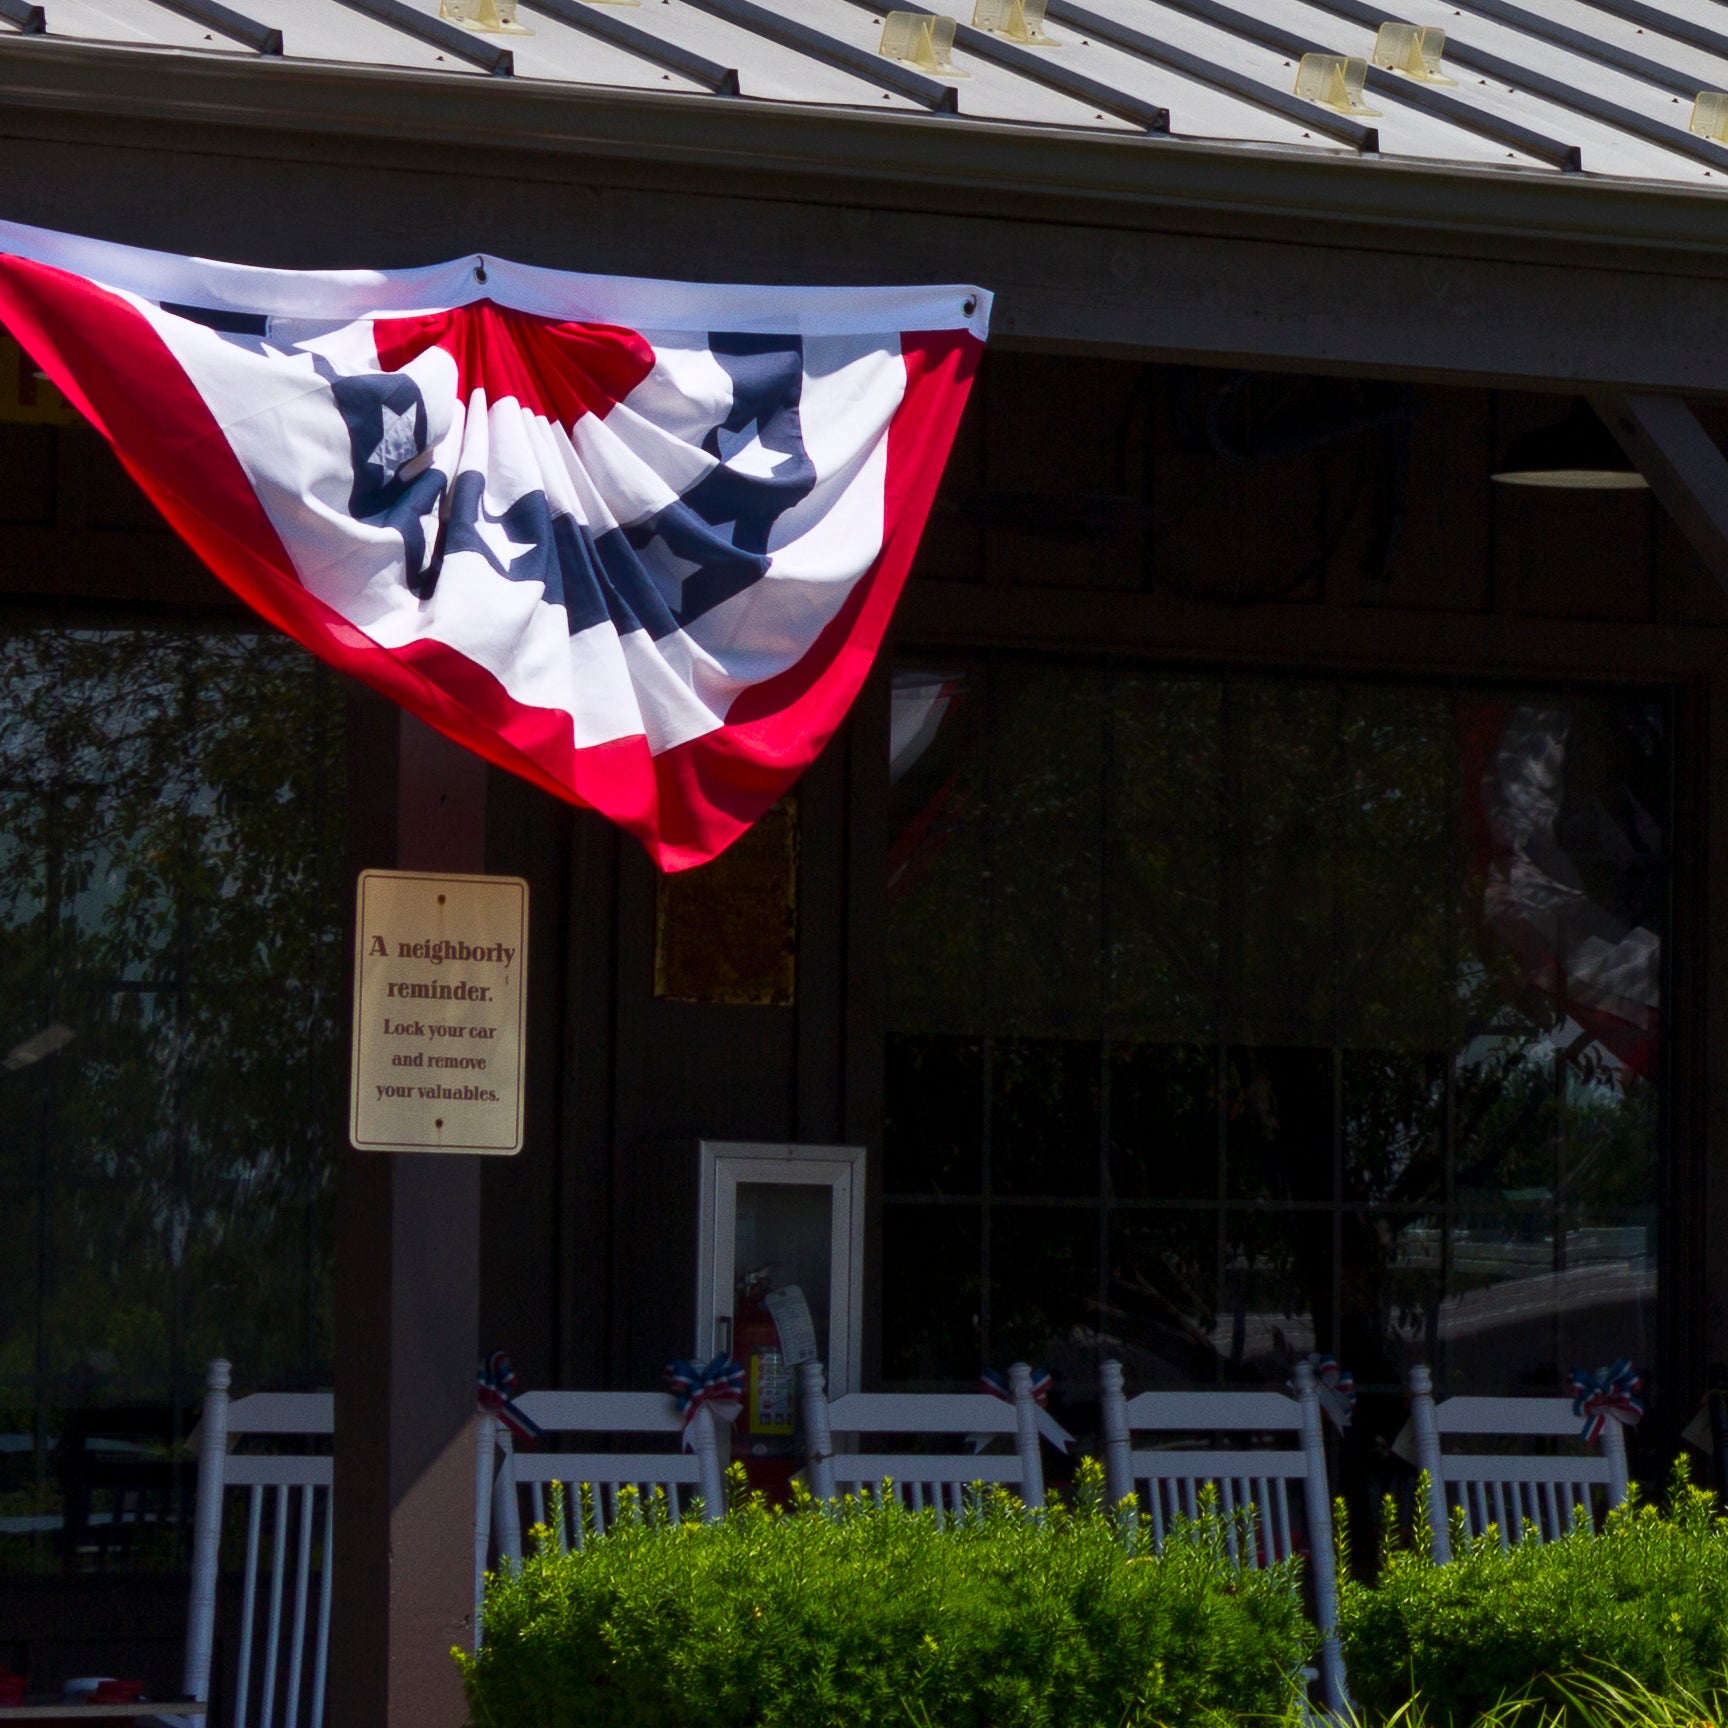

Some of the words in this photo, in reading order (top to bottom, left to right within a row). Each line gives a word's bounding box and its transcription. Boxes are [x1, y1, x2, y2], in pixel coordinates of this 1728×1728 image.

[369, 935, 389, 957] A
[397, 938, 516, 969] neighborly
[387, 979, 494, 1002] reminder.
[382, 1018, 426, 1036] Lock
[429, 1024, 467, 1041] your
[469, 1025, 498, 1040] car
[391, 1052, 424, 1068] and
[427, 1054, 487, 1070] remove
[376, 1084, 416, 1101] your
[417, 1084, 501, 1102] valuables.
